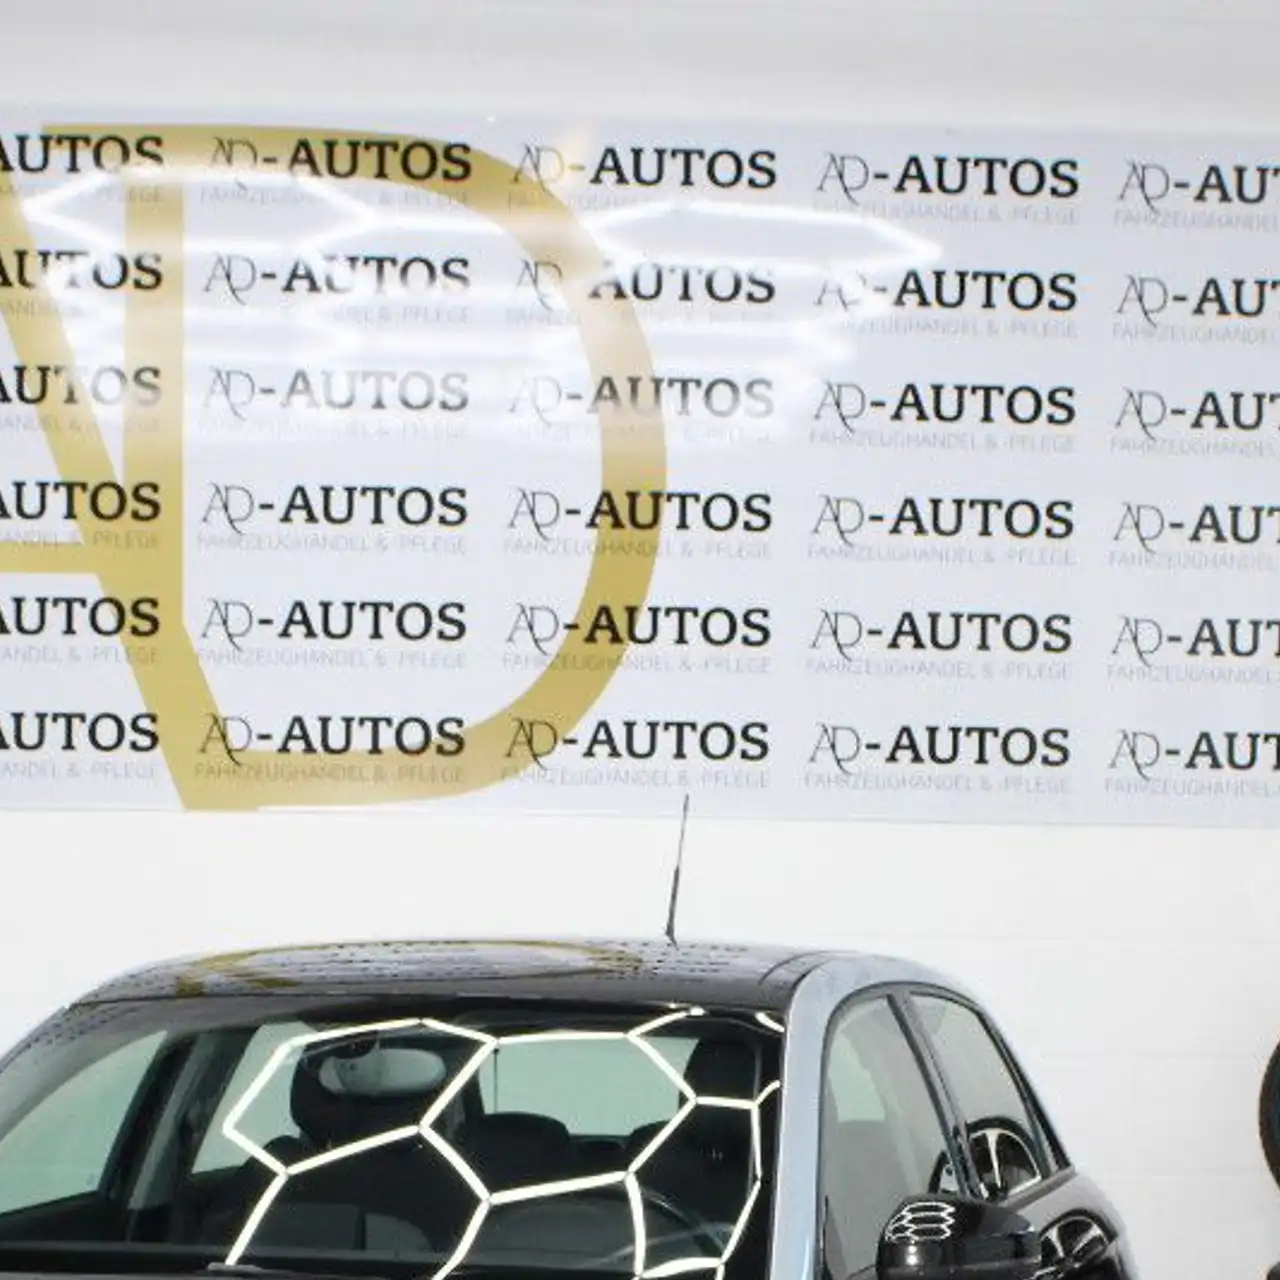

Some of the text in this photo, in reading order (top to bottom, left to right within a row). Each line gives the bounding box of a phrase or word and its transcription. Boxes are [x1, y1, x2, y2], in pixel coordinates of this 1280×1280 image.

[512, 144, 777, 198] AD-AUTOS
[816, 152, 1079, 206] AD-AUTOS
[204, 367, 469, 420] AD-AUTOS
[509, 373, 774, 427] AD-AUTOS
[814, 380, 1075, 433] AD-AUTOS
[202, 482, 468, 535] AD-AUTOS
[507, 488, 772, 540] AD-AUTOS
[813, 495, 1074, 546] AD-AUTOS
[201, 598, 466, 651] AD-AUTOS
[506, 603, 770, 655] AD-AUTOS
[811, 608, 1072, 661] AD-AUTOS
[200, 712, 465, 765] AD-AUTOS
[504, 717, 769, 770] AD-AUTOS
[808, 722, 1070, 775] AD-AUTOS
